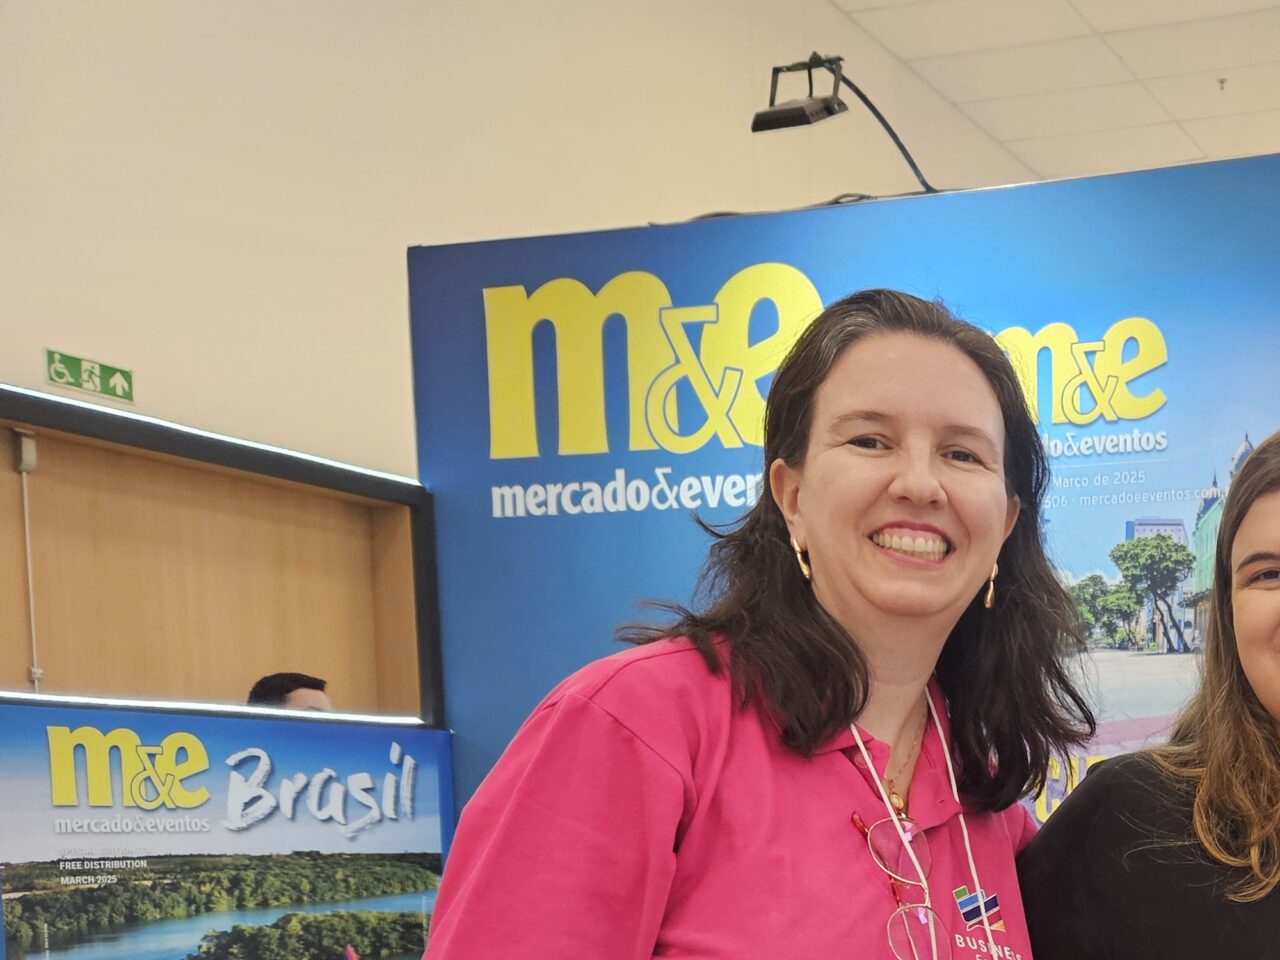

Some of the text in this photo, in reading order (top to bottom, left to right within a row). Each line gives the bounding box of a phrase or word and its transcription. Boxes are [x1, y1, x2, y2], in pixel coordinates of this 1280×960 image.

[482, 262, 825, 460] m&e
[1042, 429, 1168, 457] o&eventos
[1053, 471, 1146, 489] Março de 2025
[491, 467, 765, 519] mercado&even
[47, 726, 416, 839] m&e Brasil
[55, 814, 210, 833] mercado&eventos
[60, 860, 147, 870] FREE DISTRIBUTION
[61, 875, 117, 885] MARCH 2025
